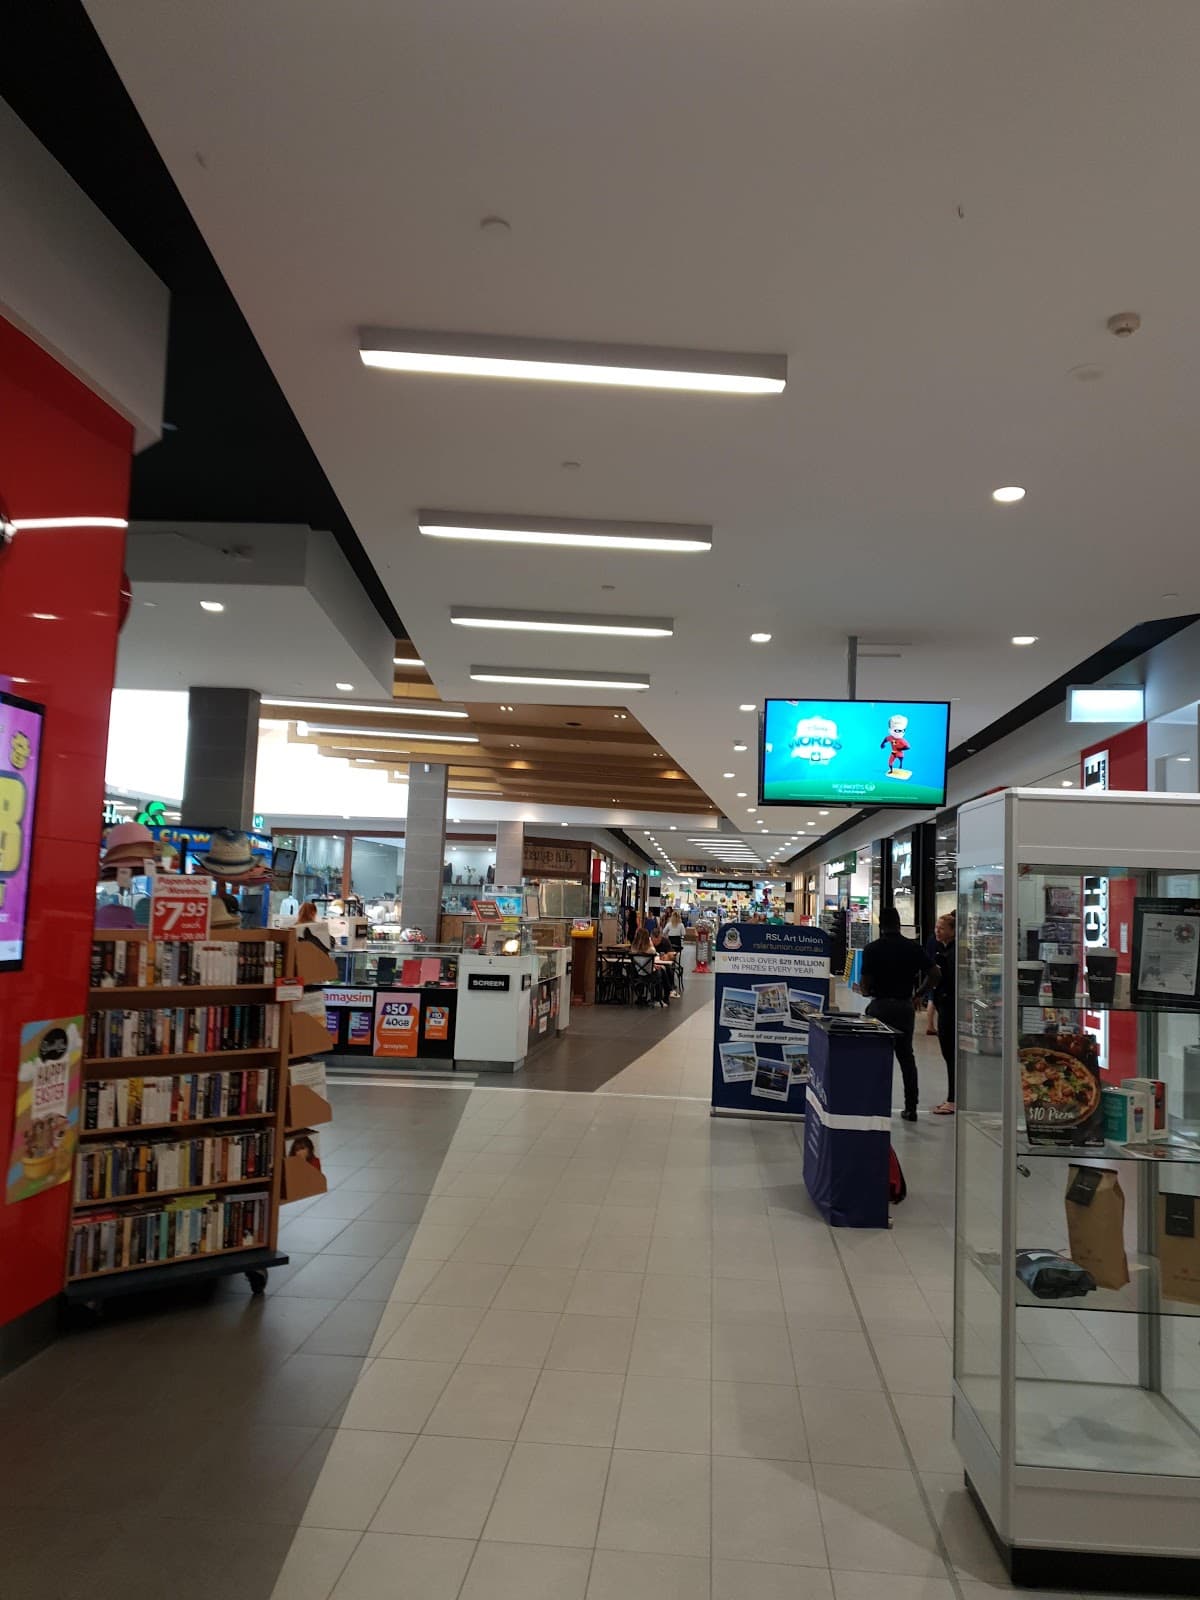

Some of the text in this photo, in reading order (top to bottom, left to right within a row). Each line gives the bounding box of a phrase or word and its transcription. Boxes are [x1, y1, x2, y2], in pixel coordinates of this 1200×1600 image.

[155, 901, 207, 931] $7.95
[765, 933, 824, 945] RSL Art Union
[757, 957, 777, 965] OVER
[794, 959, 825, 968] MILLION
[741, 964, 767, 972] PRIZES
[768, 966, 792, 974] EVERY
[793, 967, 814, 975] YEAR
[322, 991, 372, 1004] amaysim
[385, 1003, 409, 1015] $50
[385, 1018, 410, 1027] 40GB
[1029, 1107, 1045, 1120] $10
